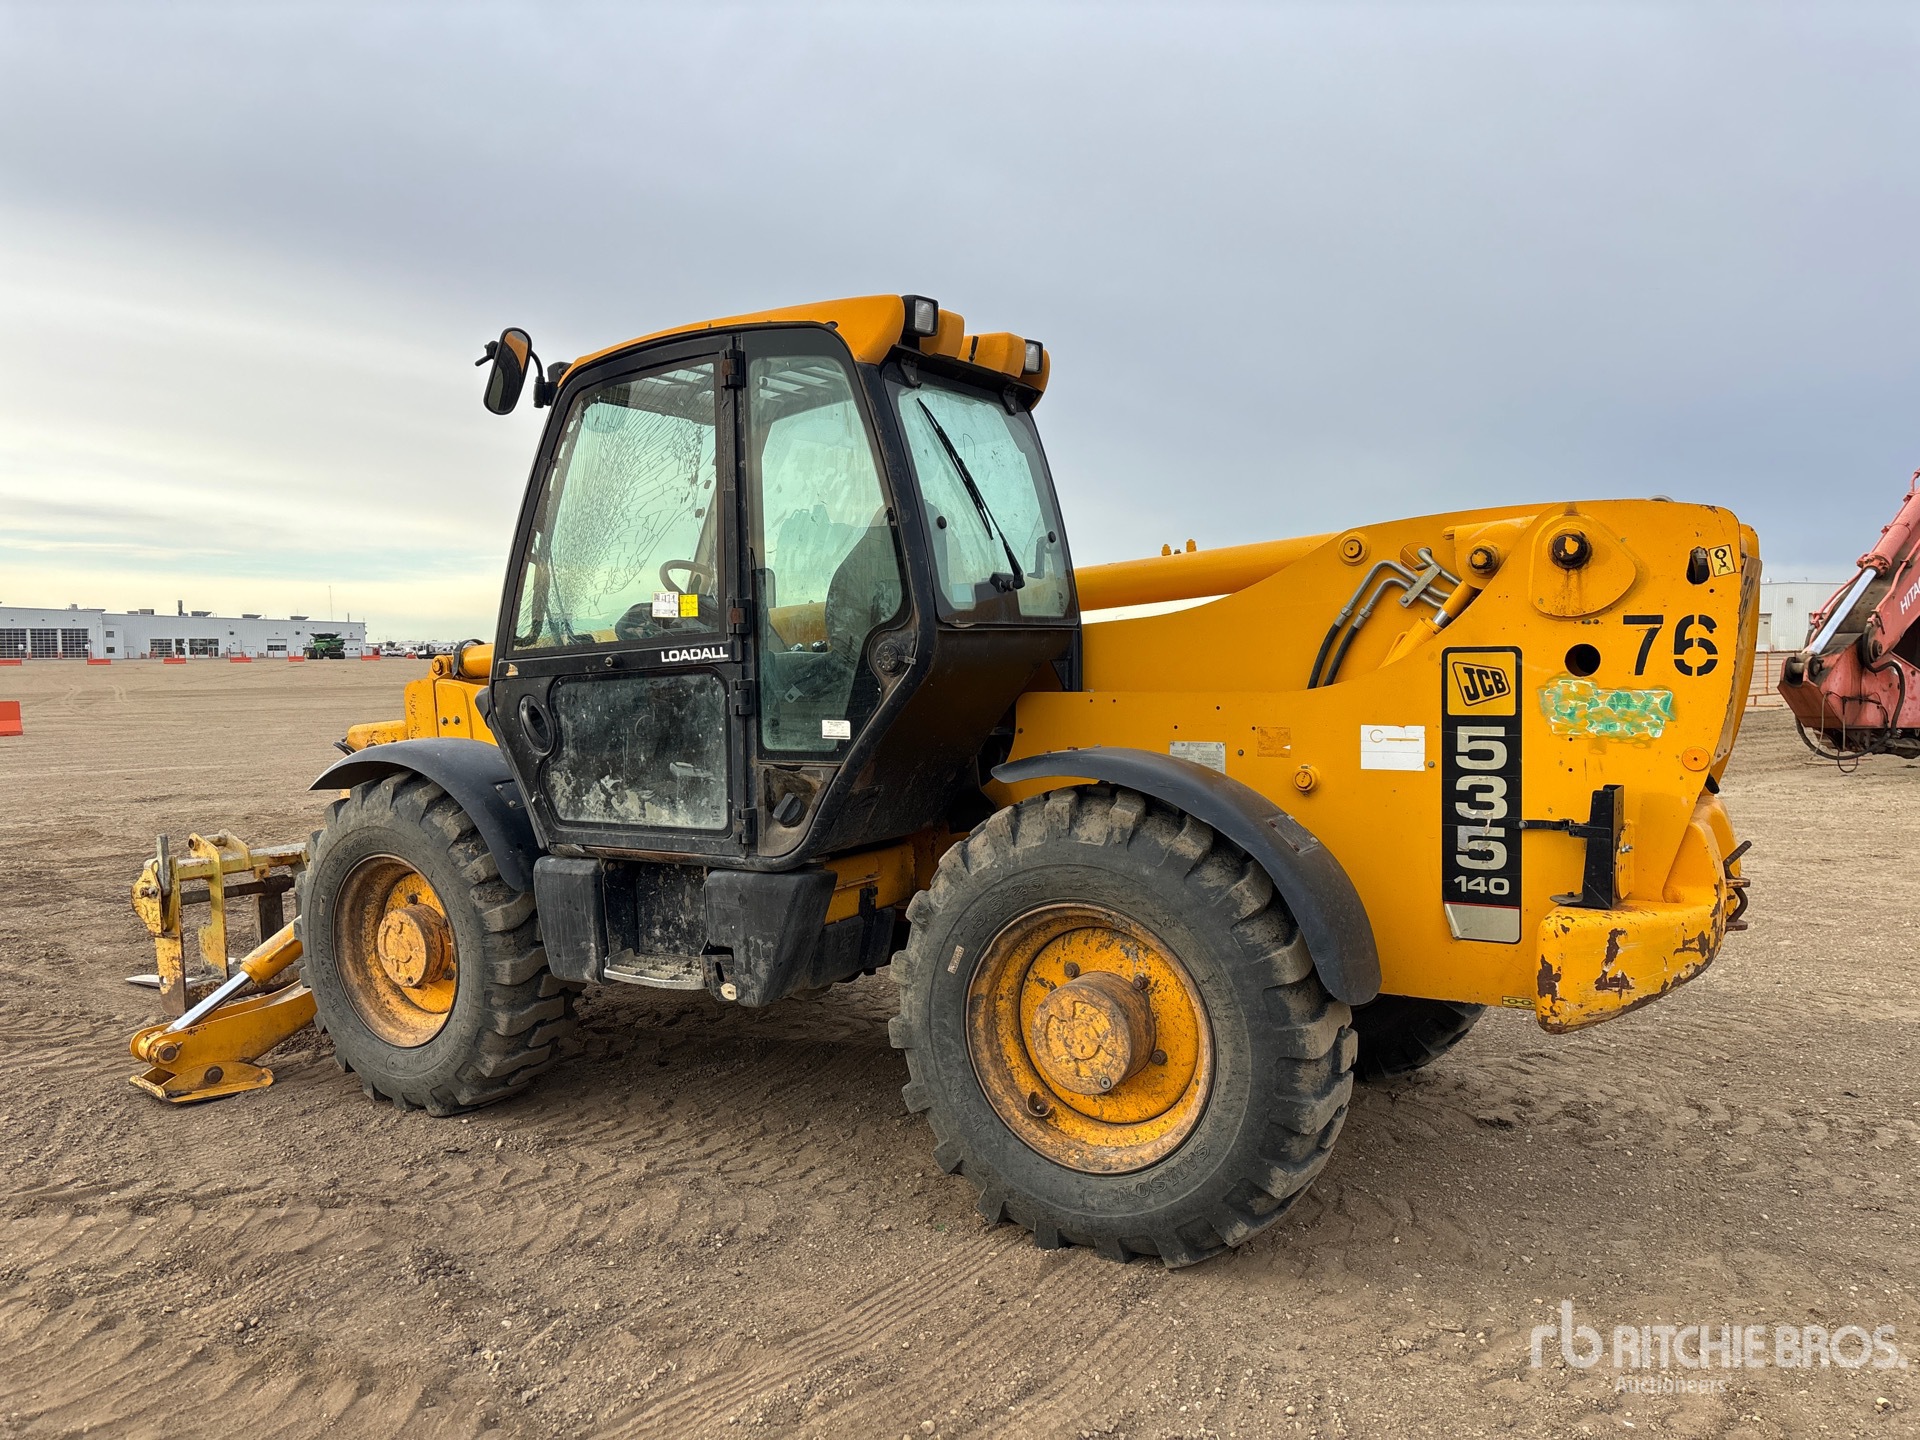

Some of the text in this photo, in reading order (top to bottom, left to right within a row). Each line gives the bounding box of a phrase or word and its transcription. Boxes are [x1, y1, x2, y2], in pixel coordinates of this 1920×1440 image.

[1900, 576, 1920, 615] HITA
[661, 646, 729, 662] LOADALL
[1623, 614, 1718, 676] 76
[1463, 666, 1507, 701] JCB
[1455, 726, 1508, 870] 535
[1453, 875, 1510, 895] 140
[1117, 1141, 1211, 1200] SAMSON
